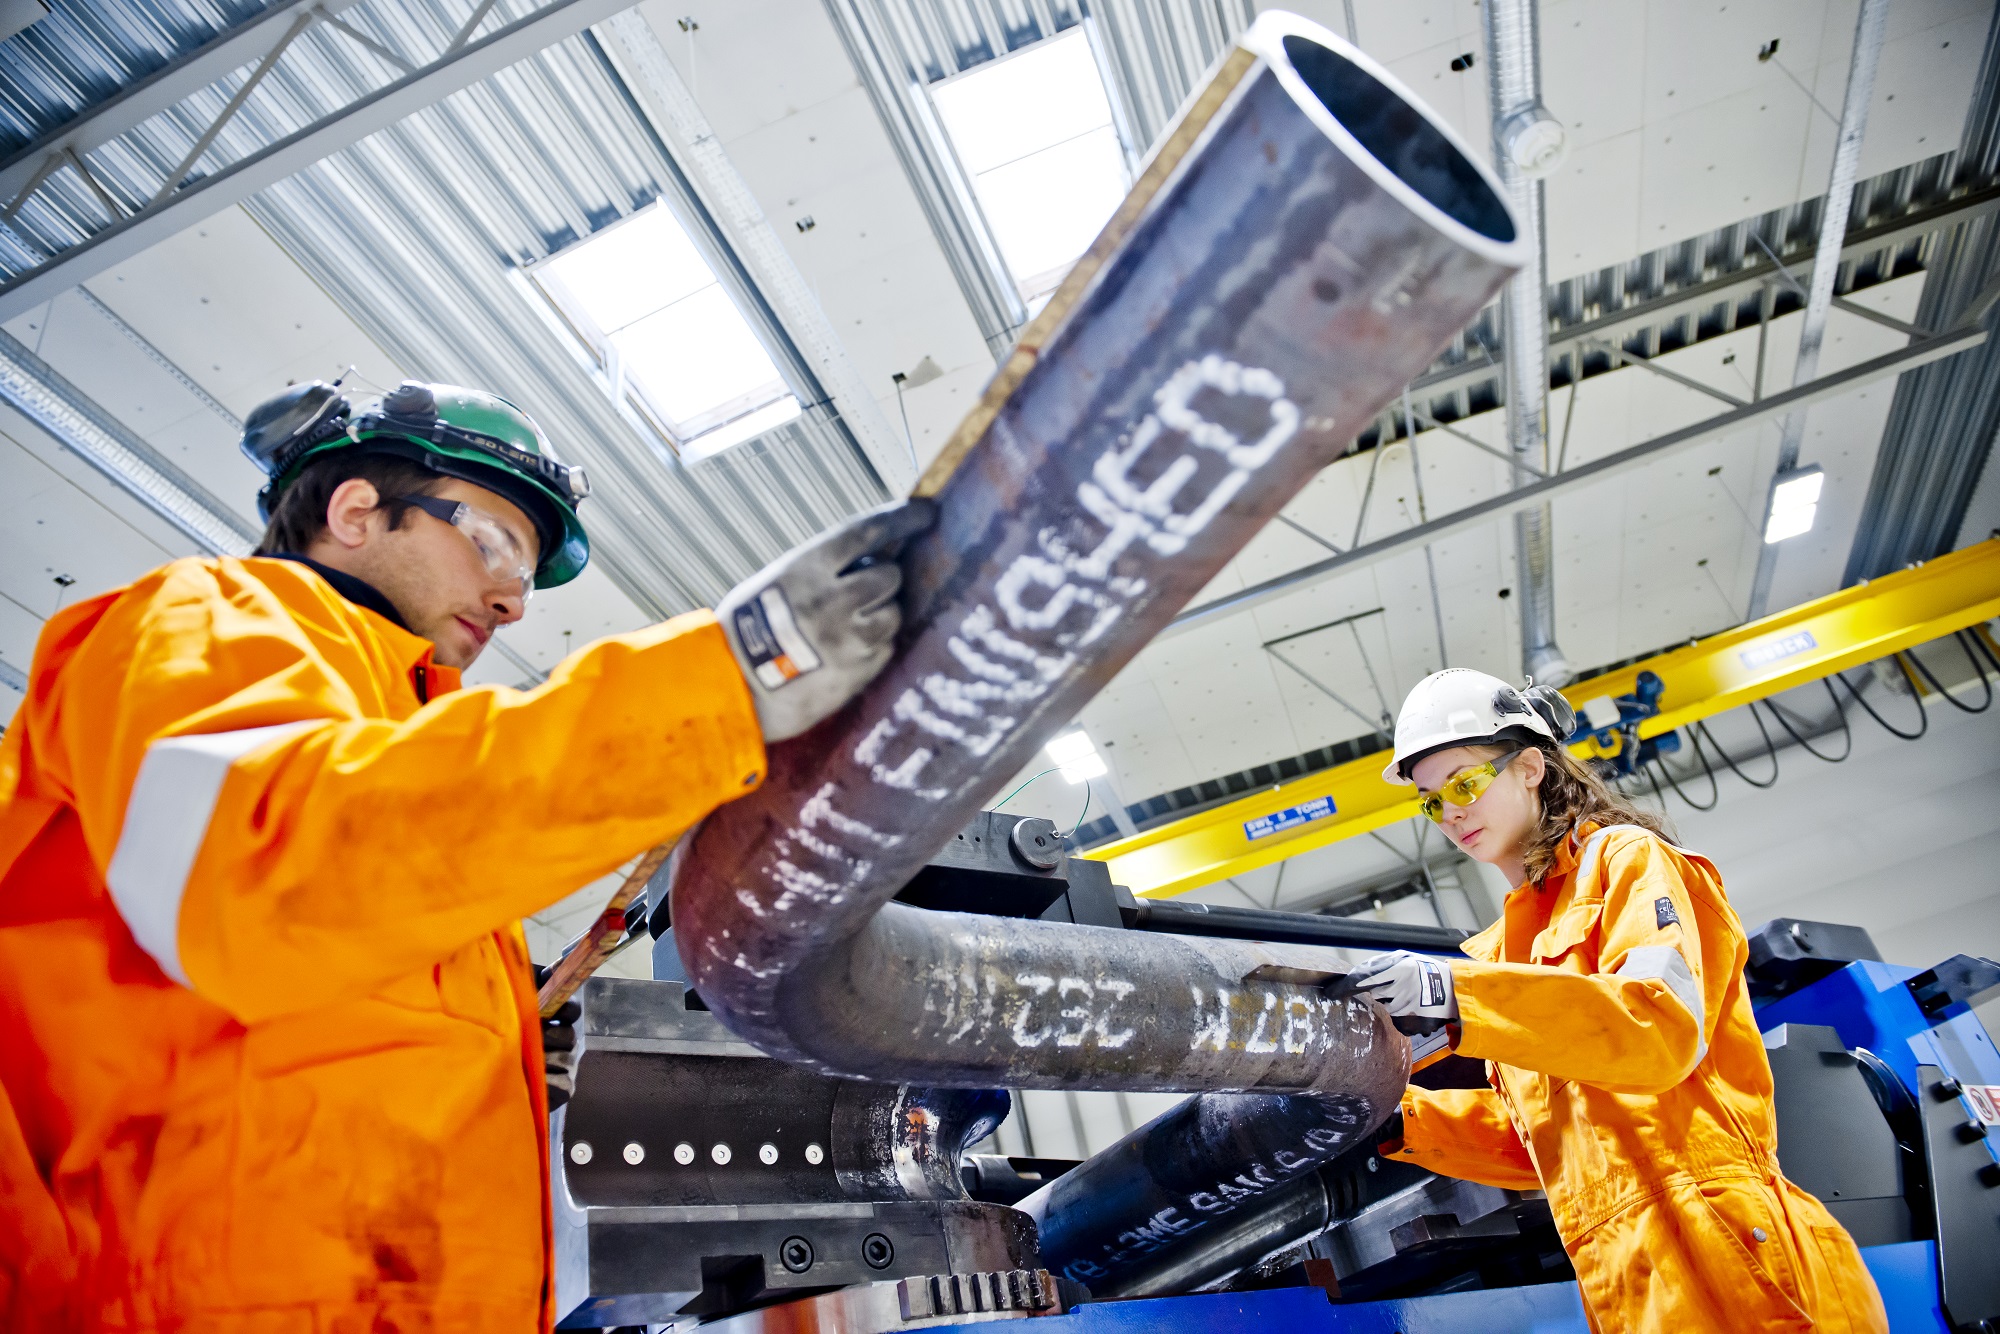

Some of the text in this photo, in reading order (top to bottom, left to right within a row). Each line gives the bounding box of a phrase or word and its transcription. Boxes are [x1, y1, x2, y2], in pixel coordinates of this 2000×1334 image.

[855, 354, 1298, 800] FINISHED
[1246, 817, 1274, 832] SWL
[1295, 797, 1328, 815] TONN
